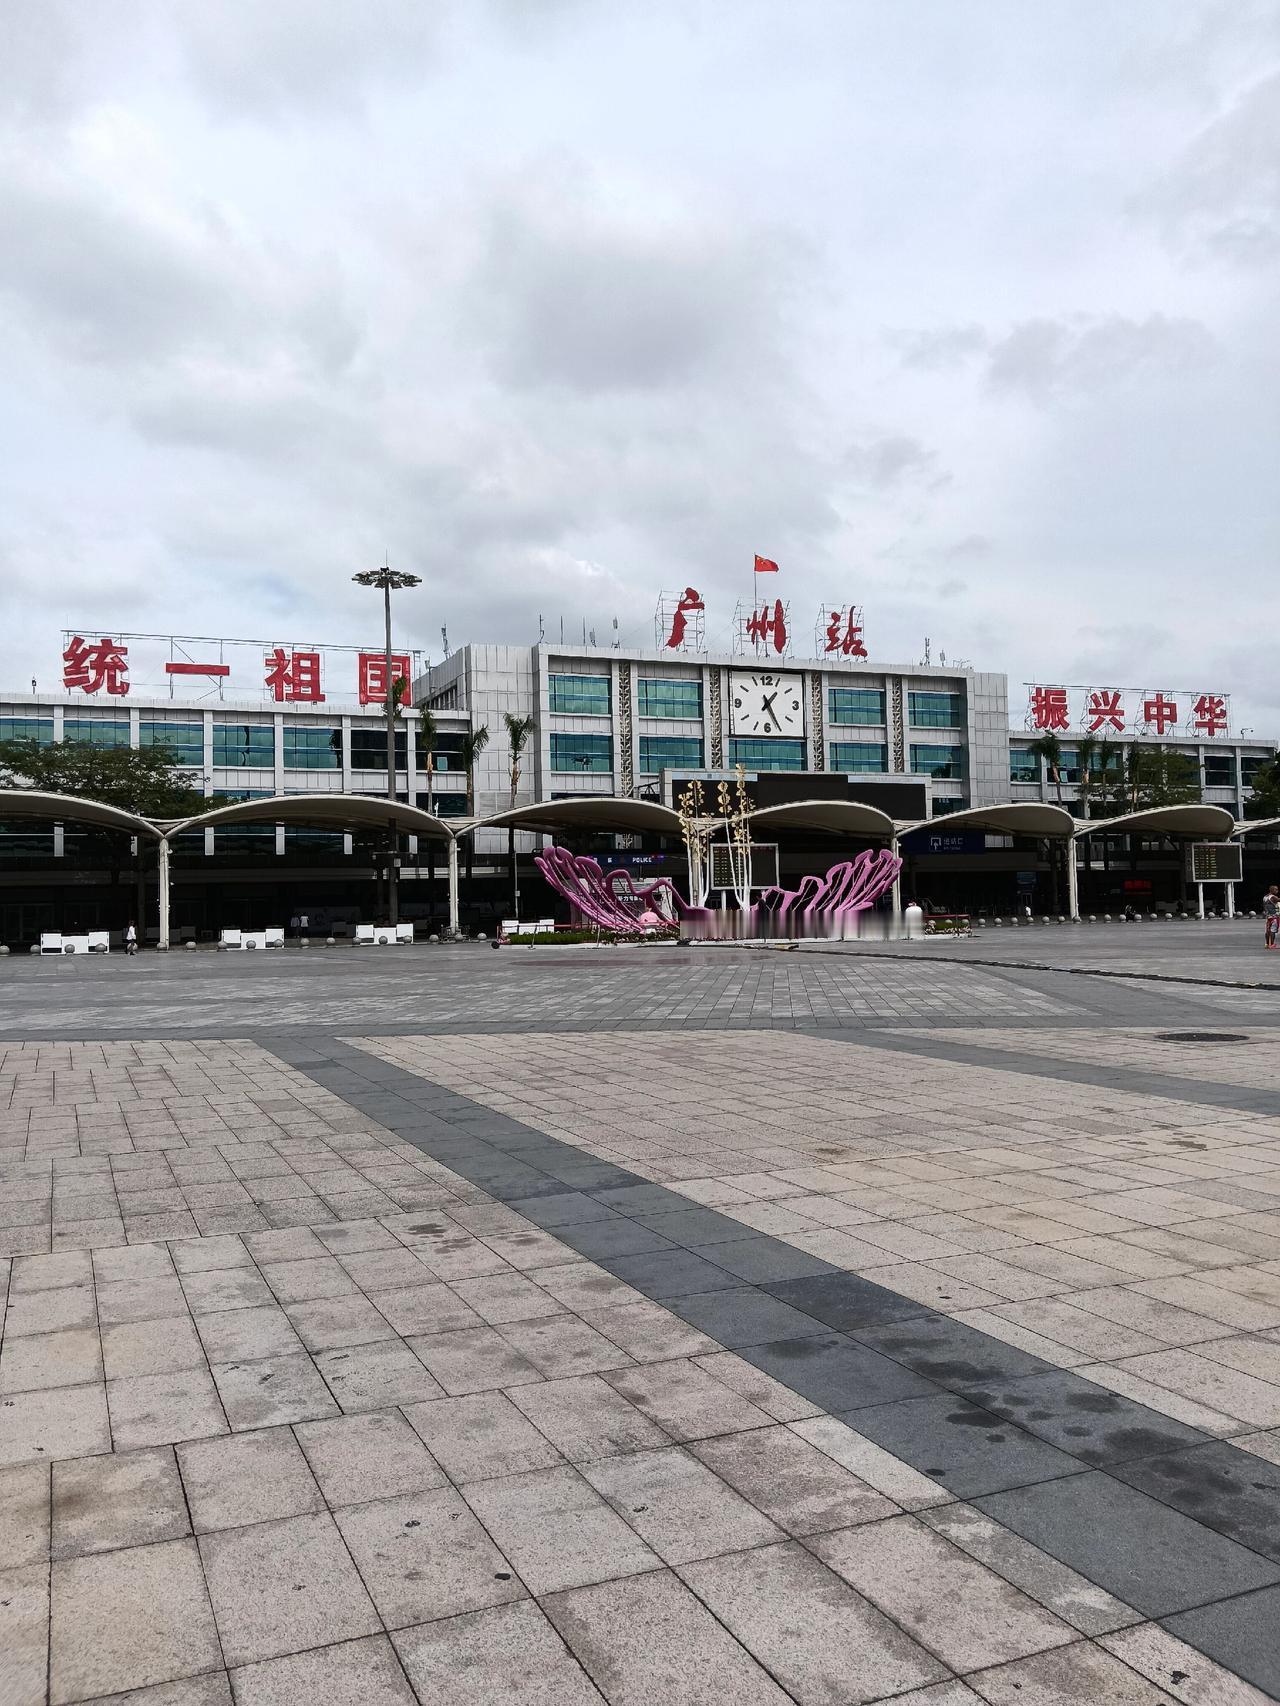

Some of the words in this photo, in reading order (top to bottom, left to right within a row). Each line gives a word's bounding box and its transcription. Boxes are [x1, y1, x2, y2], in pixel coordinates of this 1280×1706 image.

[666, 587, 867, 657] 广州站
[63, 636, 412, 706] 统一祖国
[760, 675, 773, 686] 12
[734, 698, 742, 708] 9
[792, 700, 800, 711] 3
[1031, 687, 1227, 736] 振兴中华
[764, 722, 771, 733] 6
